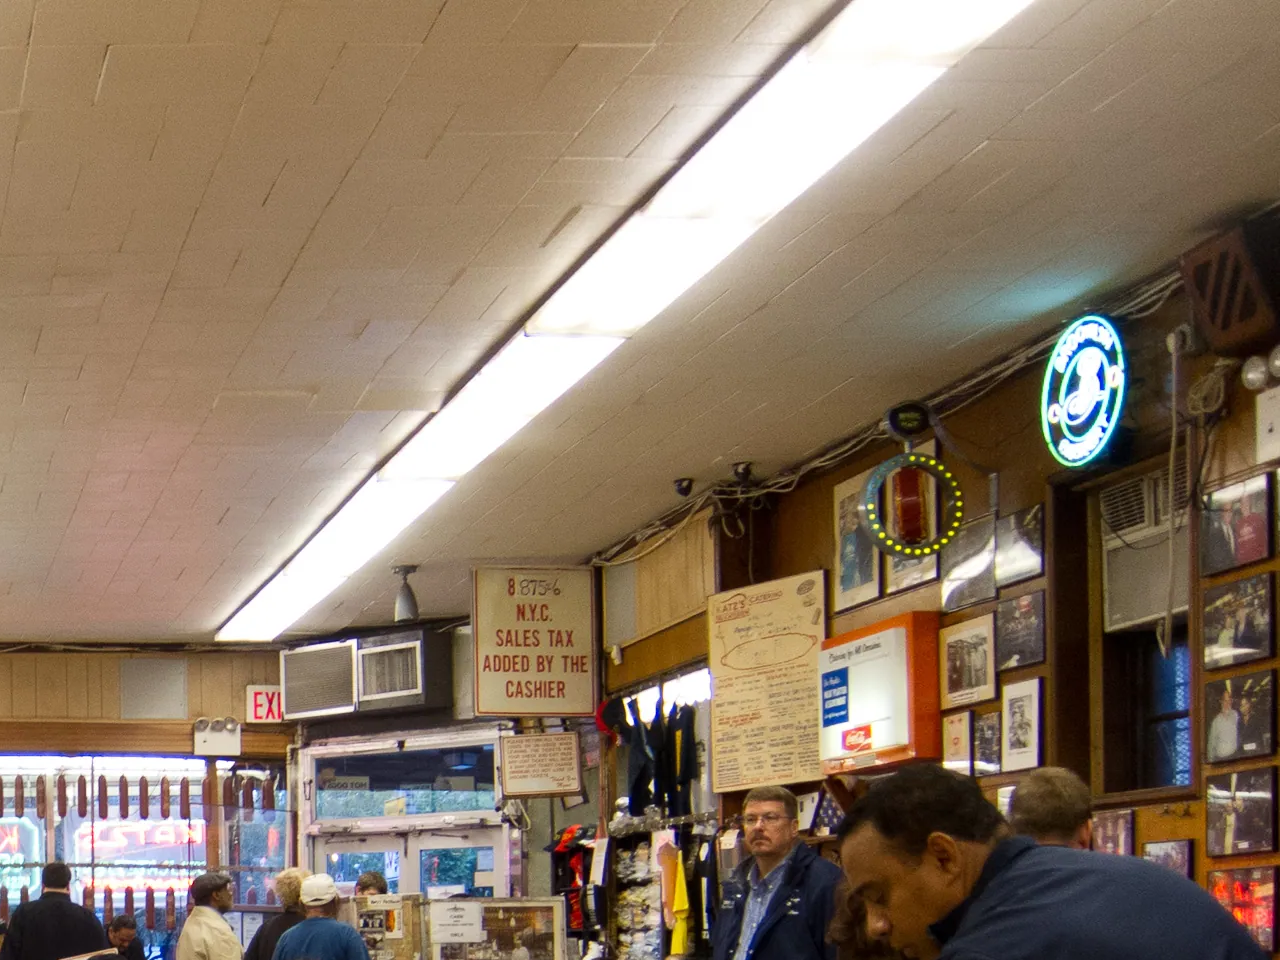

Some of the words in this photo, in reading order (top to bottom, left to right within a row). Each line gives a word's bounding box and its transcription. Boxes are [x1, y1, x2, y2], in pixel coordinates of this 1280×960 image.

[516, 604, 553, 622] N.Y.C.
[496, 629, 540, 647] SALES
[547, 630, 574, 647] TAX
[483, 655, 529, 672] ADDED
[536, 656, 554, 672] BY
[561, 656, 588, 673] THE
[506, 680, 565, 698] CASHIER
[253, 691, 281, 720] EXI
